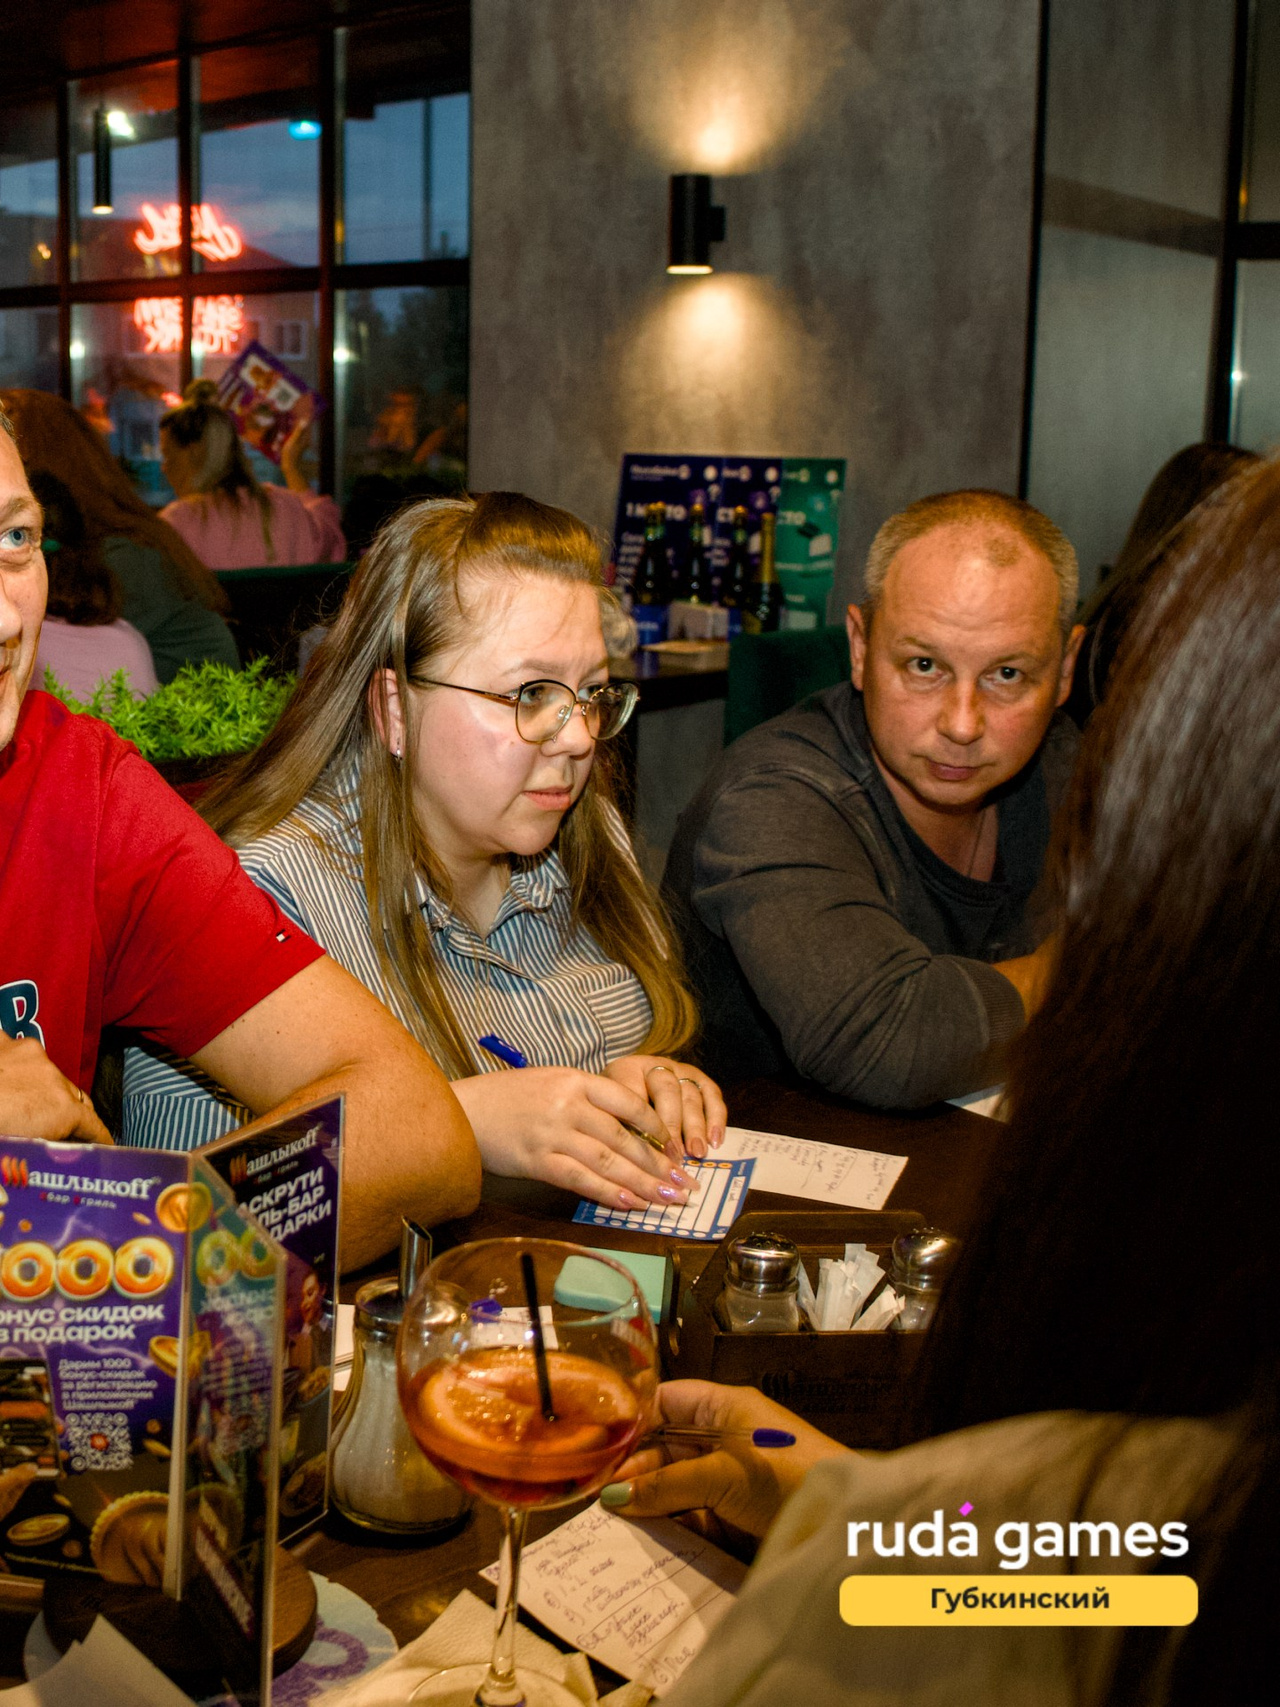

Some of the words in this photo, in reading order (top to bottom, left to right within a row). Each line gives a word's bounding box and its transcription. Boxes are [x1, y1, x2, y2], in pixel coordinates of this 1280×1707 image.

[58, 1302, 165, 1326] скидок
[12, 1322, 136, 1346] подарок
[102, 1357, 132, 1369] 1000
